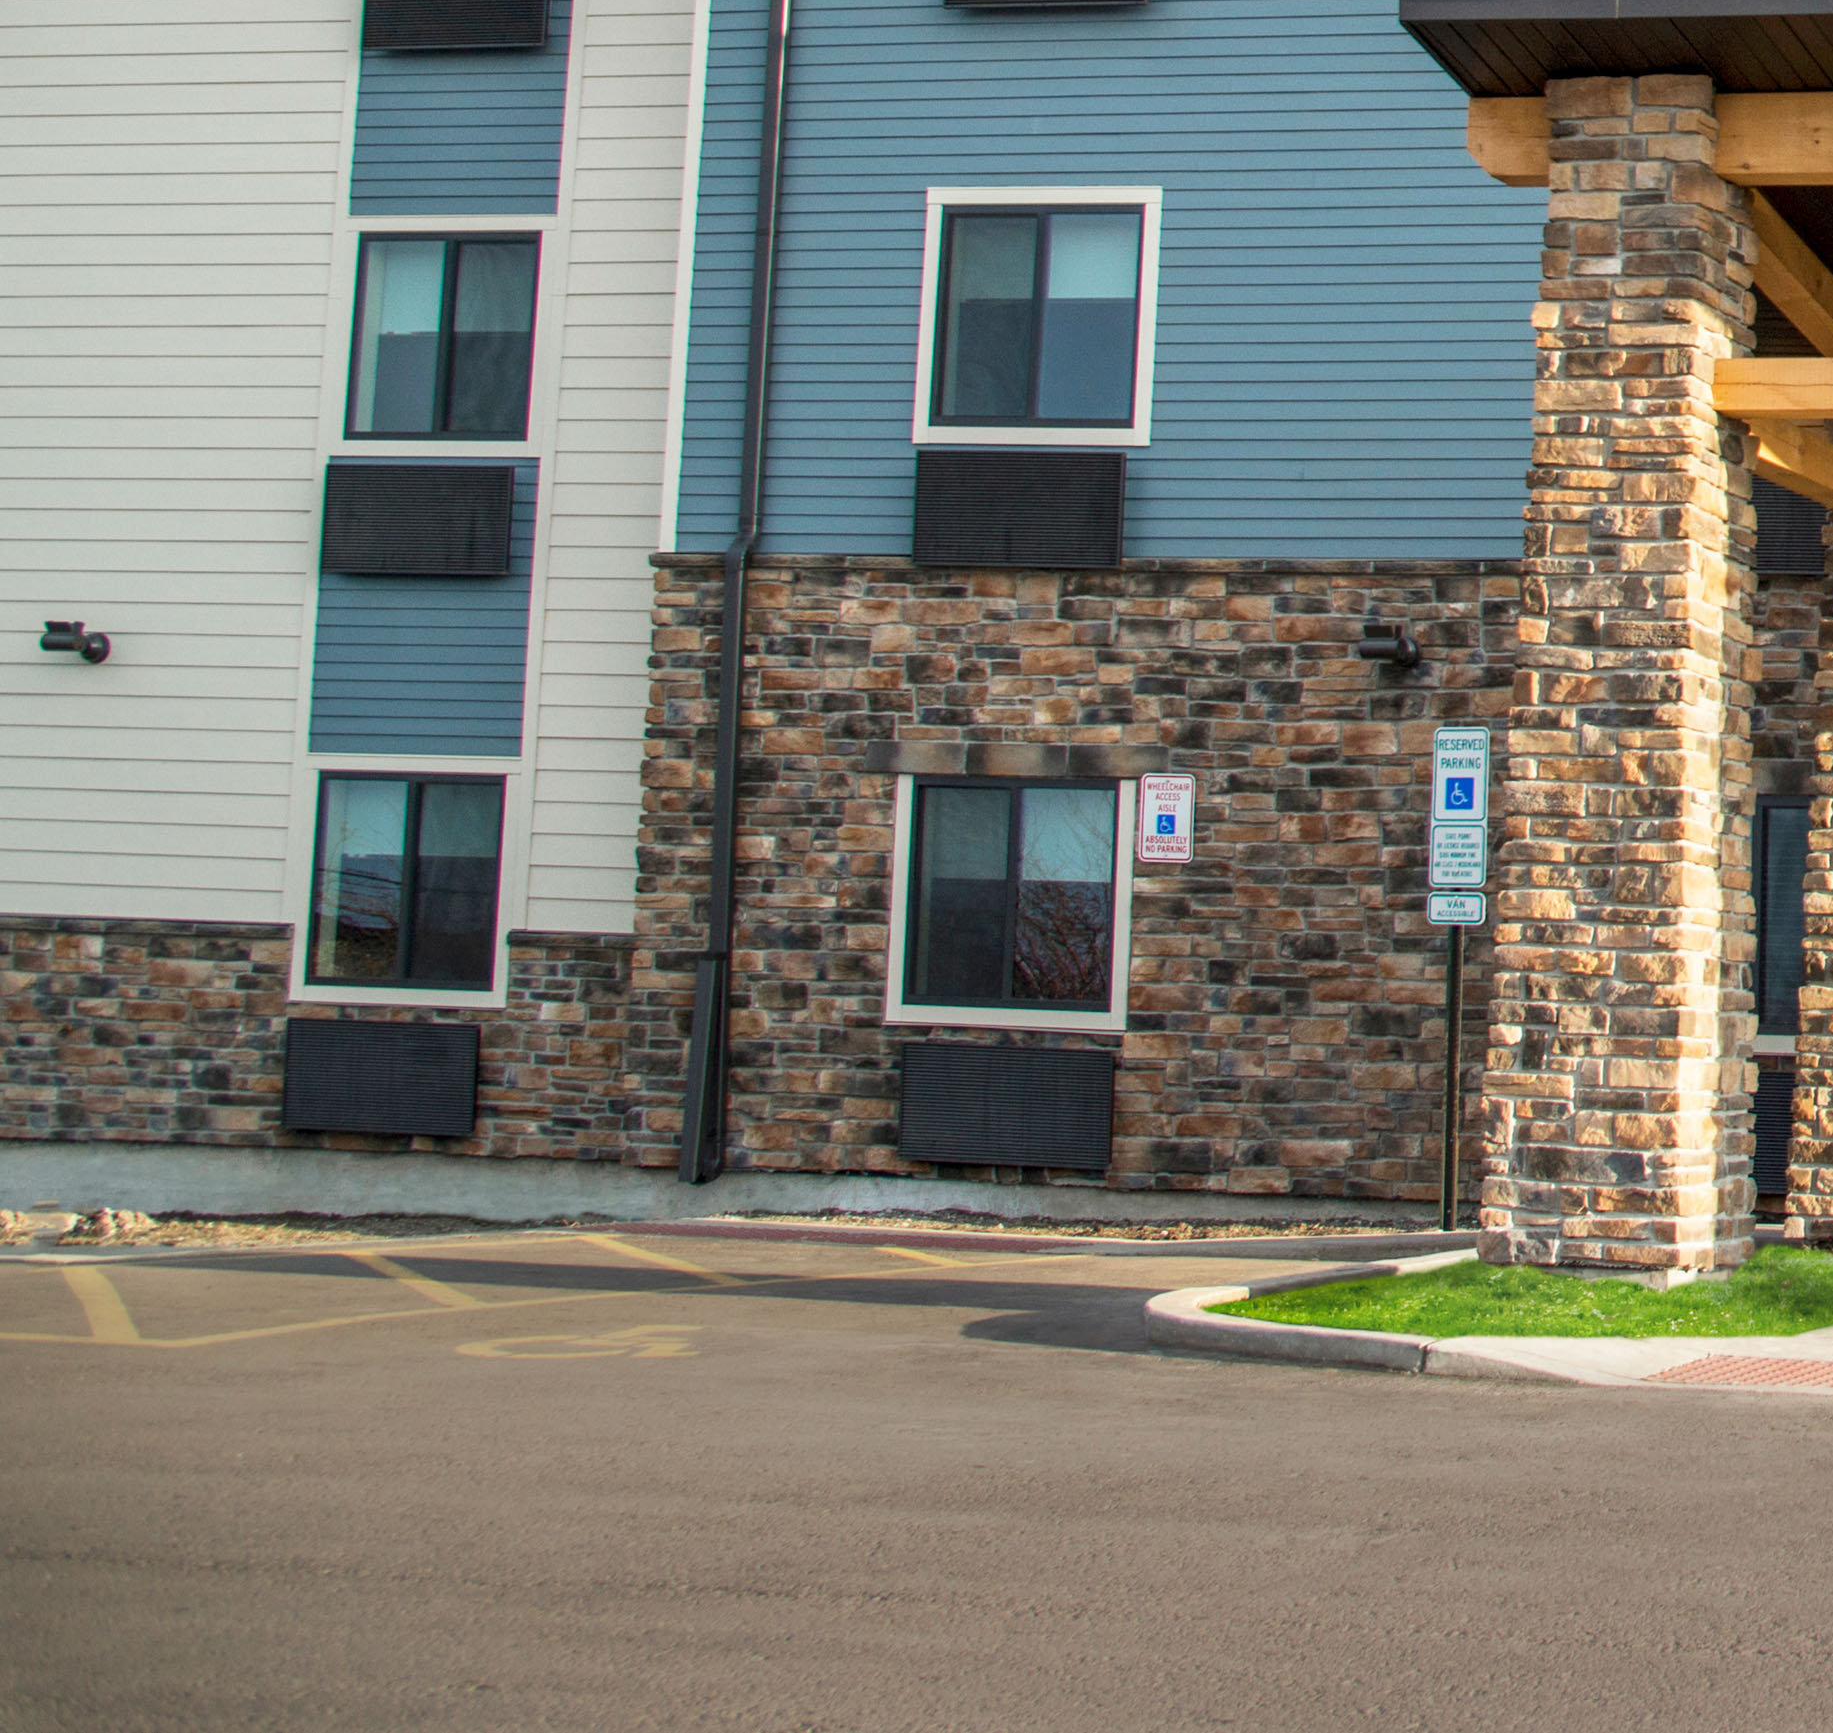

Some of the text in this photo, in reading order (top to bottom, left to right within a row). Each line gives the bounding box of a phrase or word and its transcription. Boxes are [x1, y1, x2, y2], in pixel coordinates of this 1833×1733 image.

[1438, 738, 1485, 751] RESERVED
[1440, 757, 1481, 769] PARKING
[1147, 783, 1190, 791] WHEELCHAIR
[1155, 793, 1181, 801] ACCESS
[1158, 804, 1177, 812] AISLE
[1145, 836, 1188, 844] ABSOLUTELY
[1145, 845, 1188, 854] NO PARKING
[1447, 899, 1466, 909] VAN
